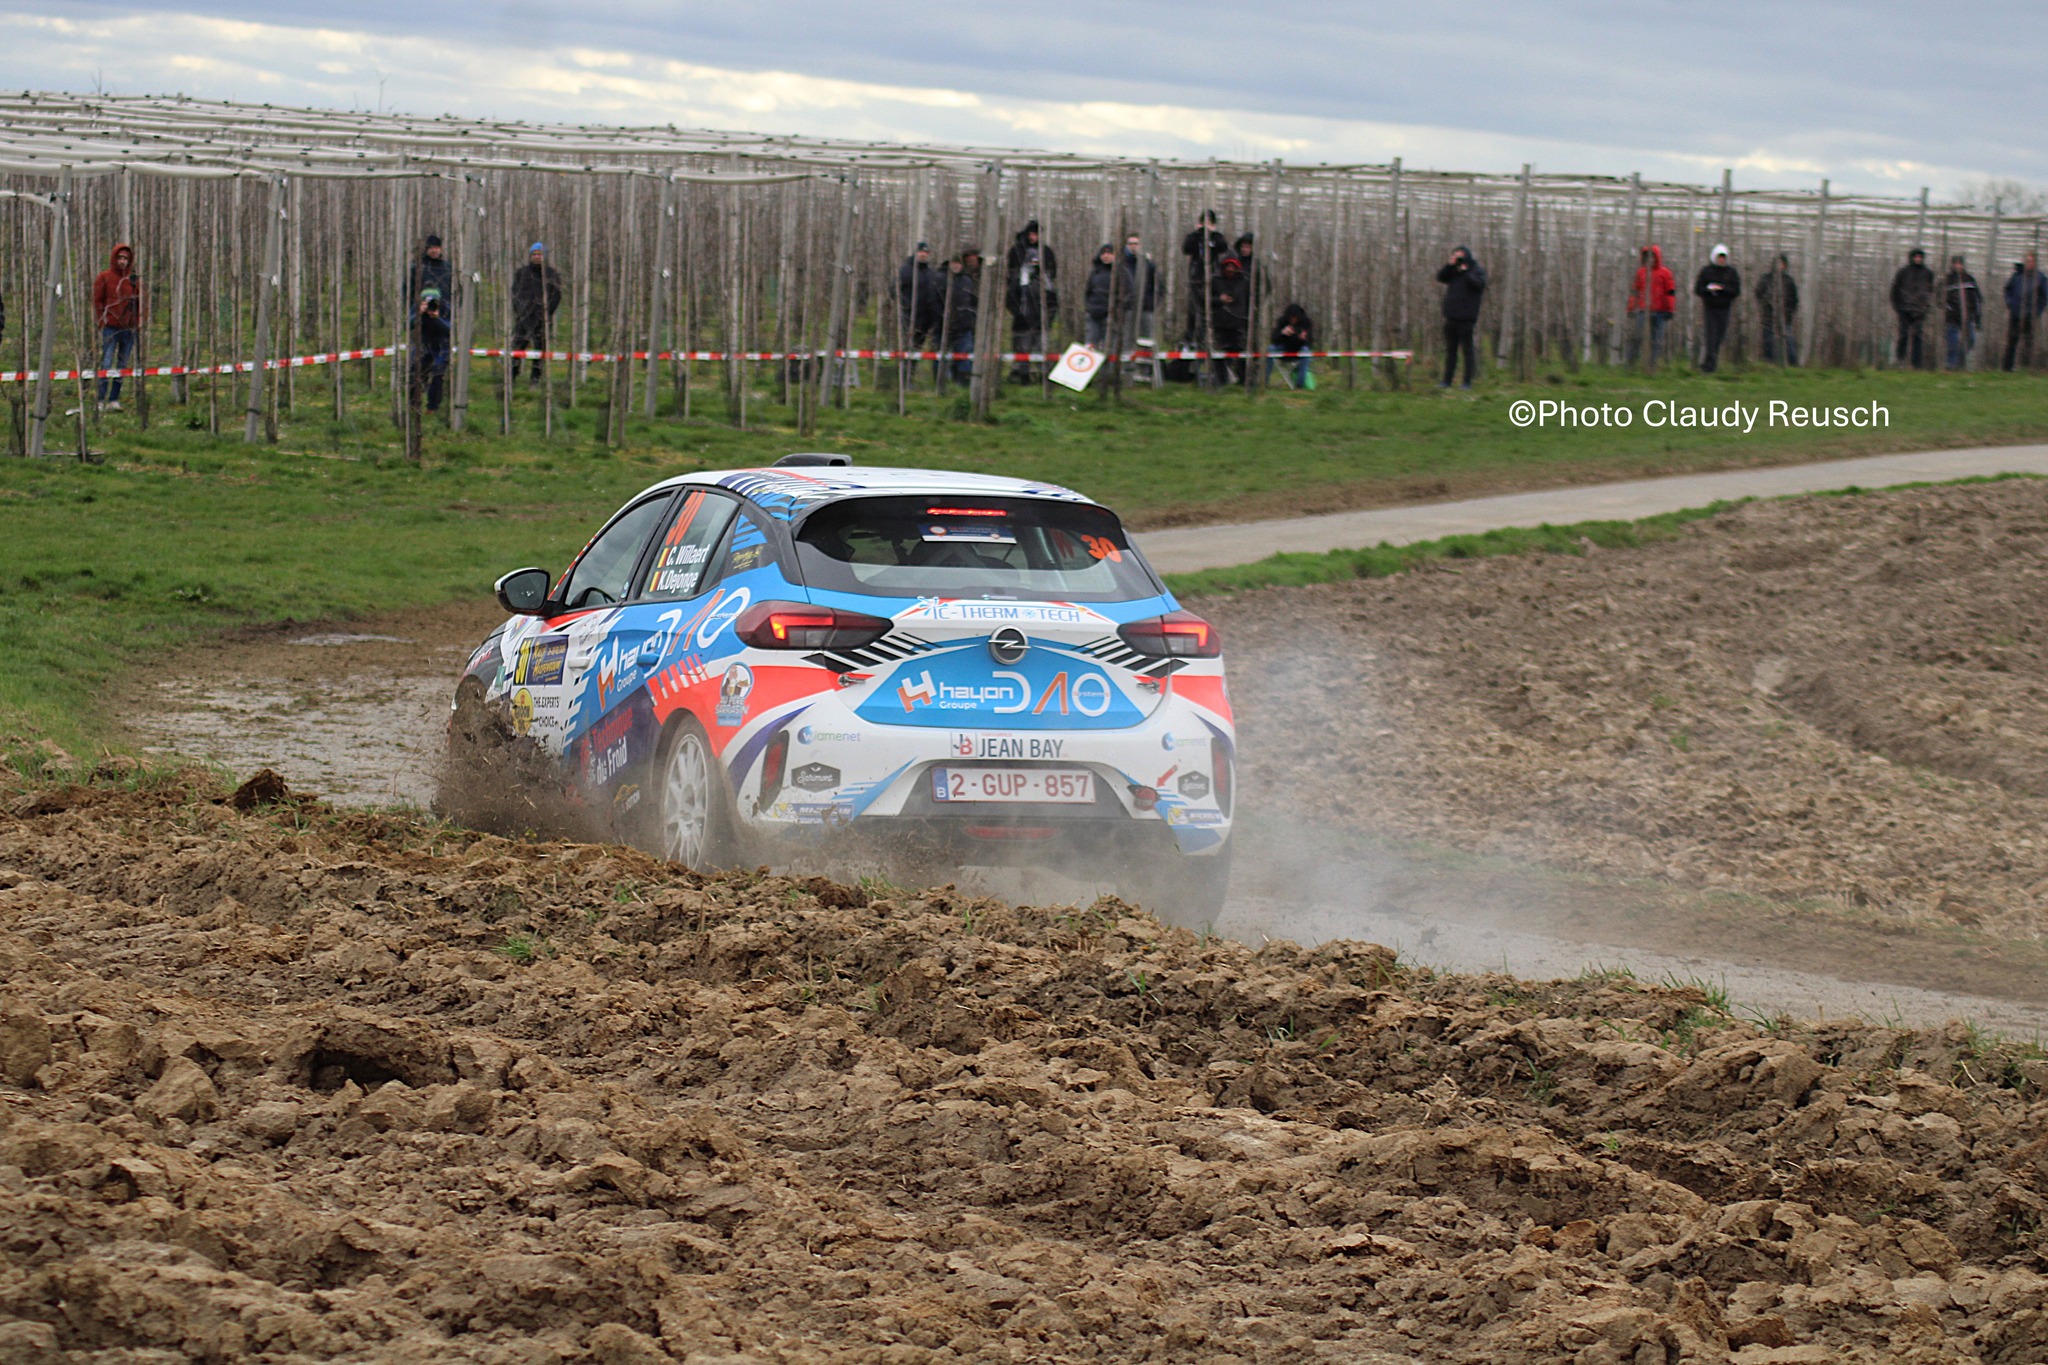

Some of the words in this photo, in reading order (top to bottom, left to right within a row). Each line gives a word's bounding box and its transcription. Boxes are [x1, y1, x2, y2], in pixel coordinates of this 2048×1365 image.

[675, 543, 711, 565] Willaert
[1081, 534, 1122, 563] 30
[1039, 608, 1080, 622] TECH
[617, 669, 637, 692] Groupe
[939, 682, 1014, 703] hayon
[939, 700, 977, 710] Groupe
[606, 735, 628, 778] Froid
[978, 738, 1023, 758] JEAN
[1030, 739, 1064, 759] BAY
[935, 786, 948, 798] B
